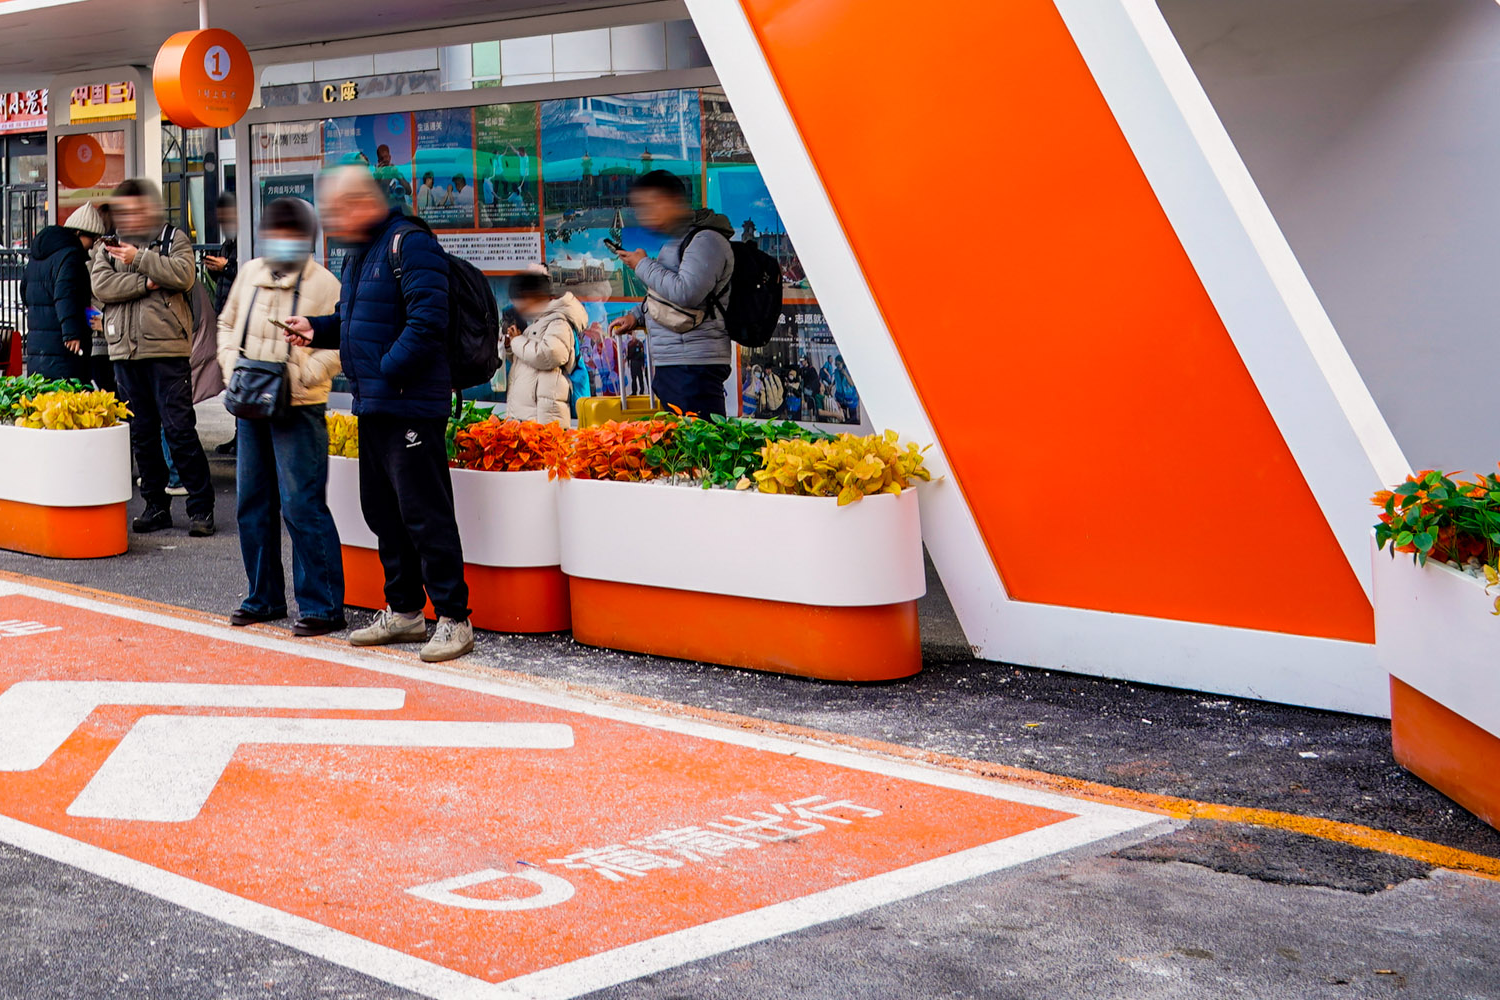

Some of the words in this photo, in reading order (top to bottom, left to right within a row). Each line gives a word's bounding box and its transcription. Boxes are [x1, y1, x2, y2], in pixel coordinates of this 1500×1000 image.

[211, 52, 222, 75] 1
[293, 133, 308, 145] 公益
[547, 795, 883, 882] 滴滴出行
